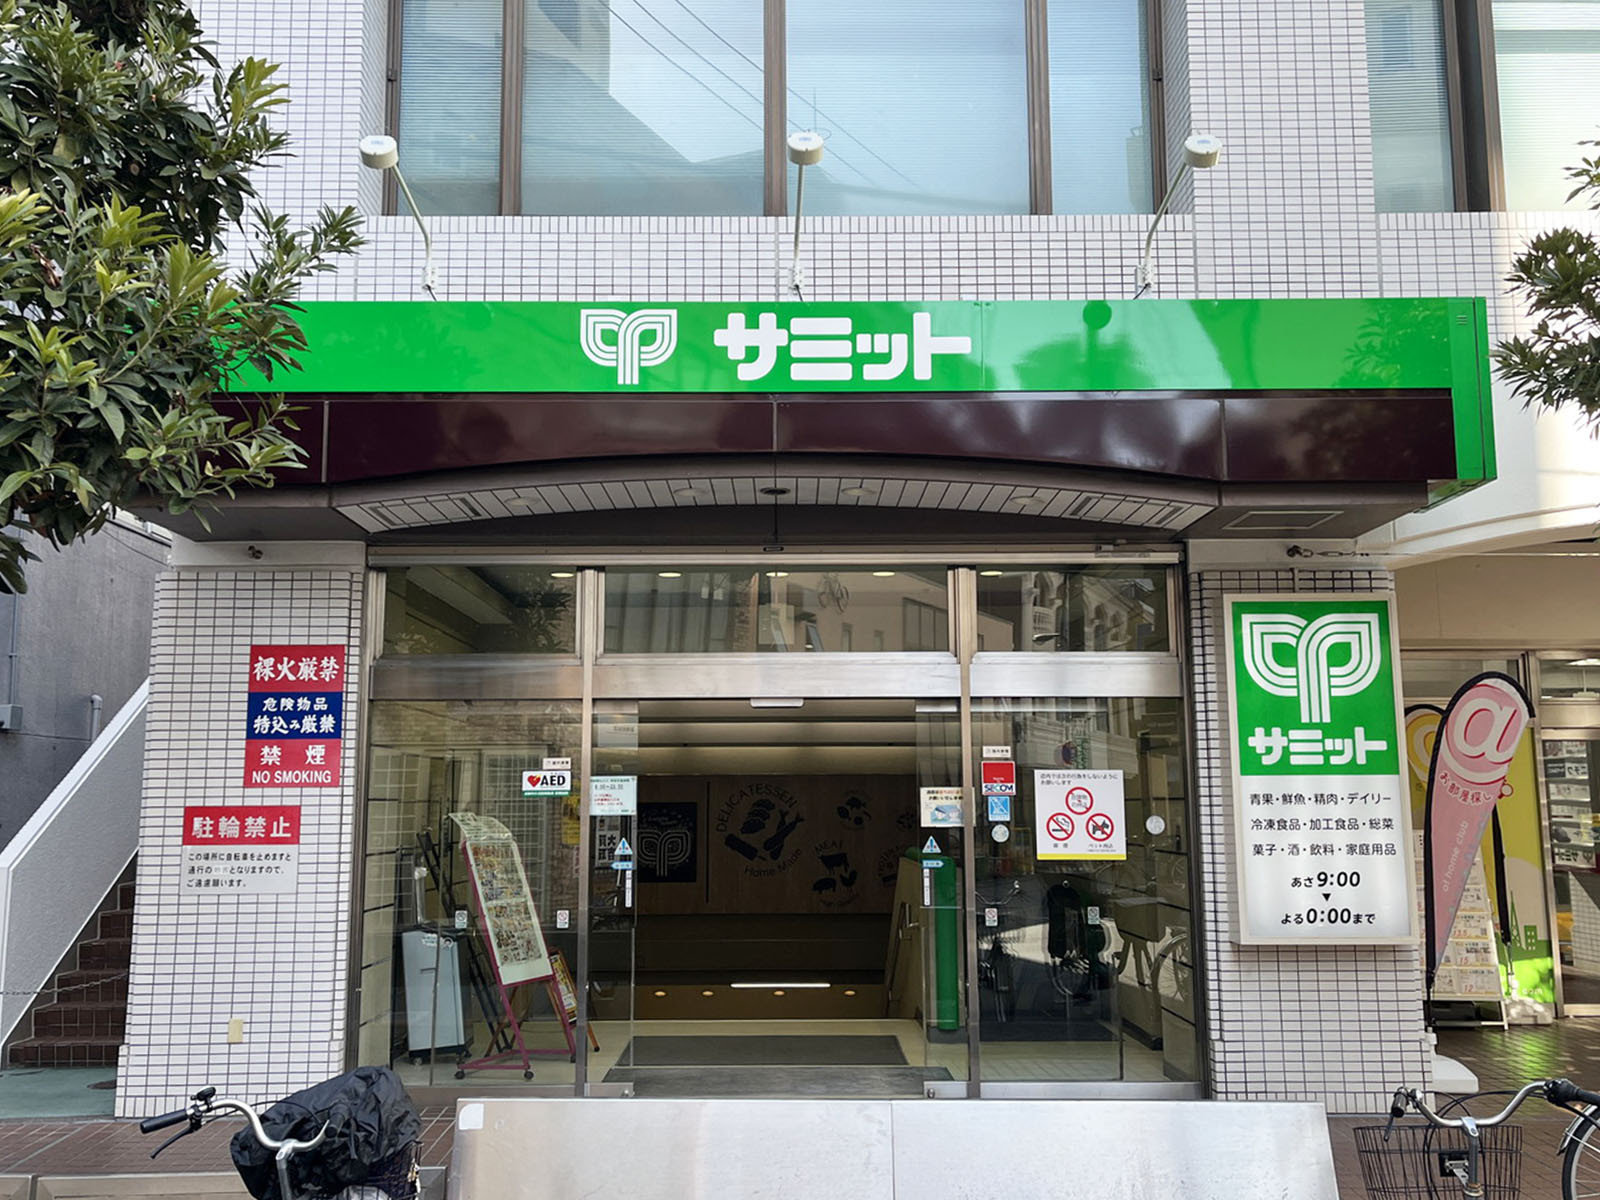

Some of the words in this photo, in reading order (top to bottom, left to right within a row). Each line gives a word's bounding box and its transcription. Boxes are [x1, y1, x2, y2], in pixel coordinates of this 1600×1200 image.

[713, 312, 972, 382] サミット
[253, 656, 340, 682] 裸火厳禁
[262, 696, 328, 712] 危険物品
[253, 714, 336, 734] 持込み厳禁
[1247, 726, 1388, 766] サミット
[251, 770, 271, 784] NO
[274, 769, 332, 784] SMOKING
[540, 774, 567, 787] AED
[984, 784, 1014, 793] SECOM
[191, 815, 292, 839] 駐輪禁止
[1456, 820, 1469, 846] club
